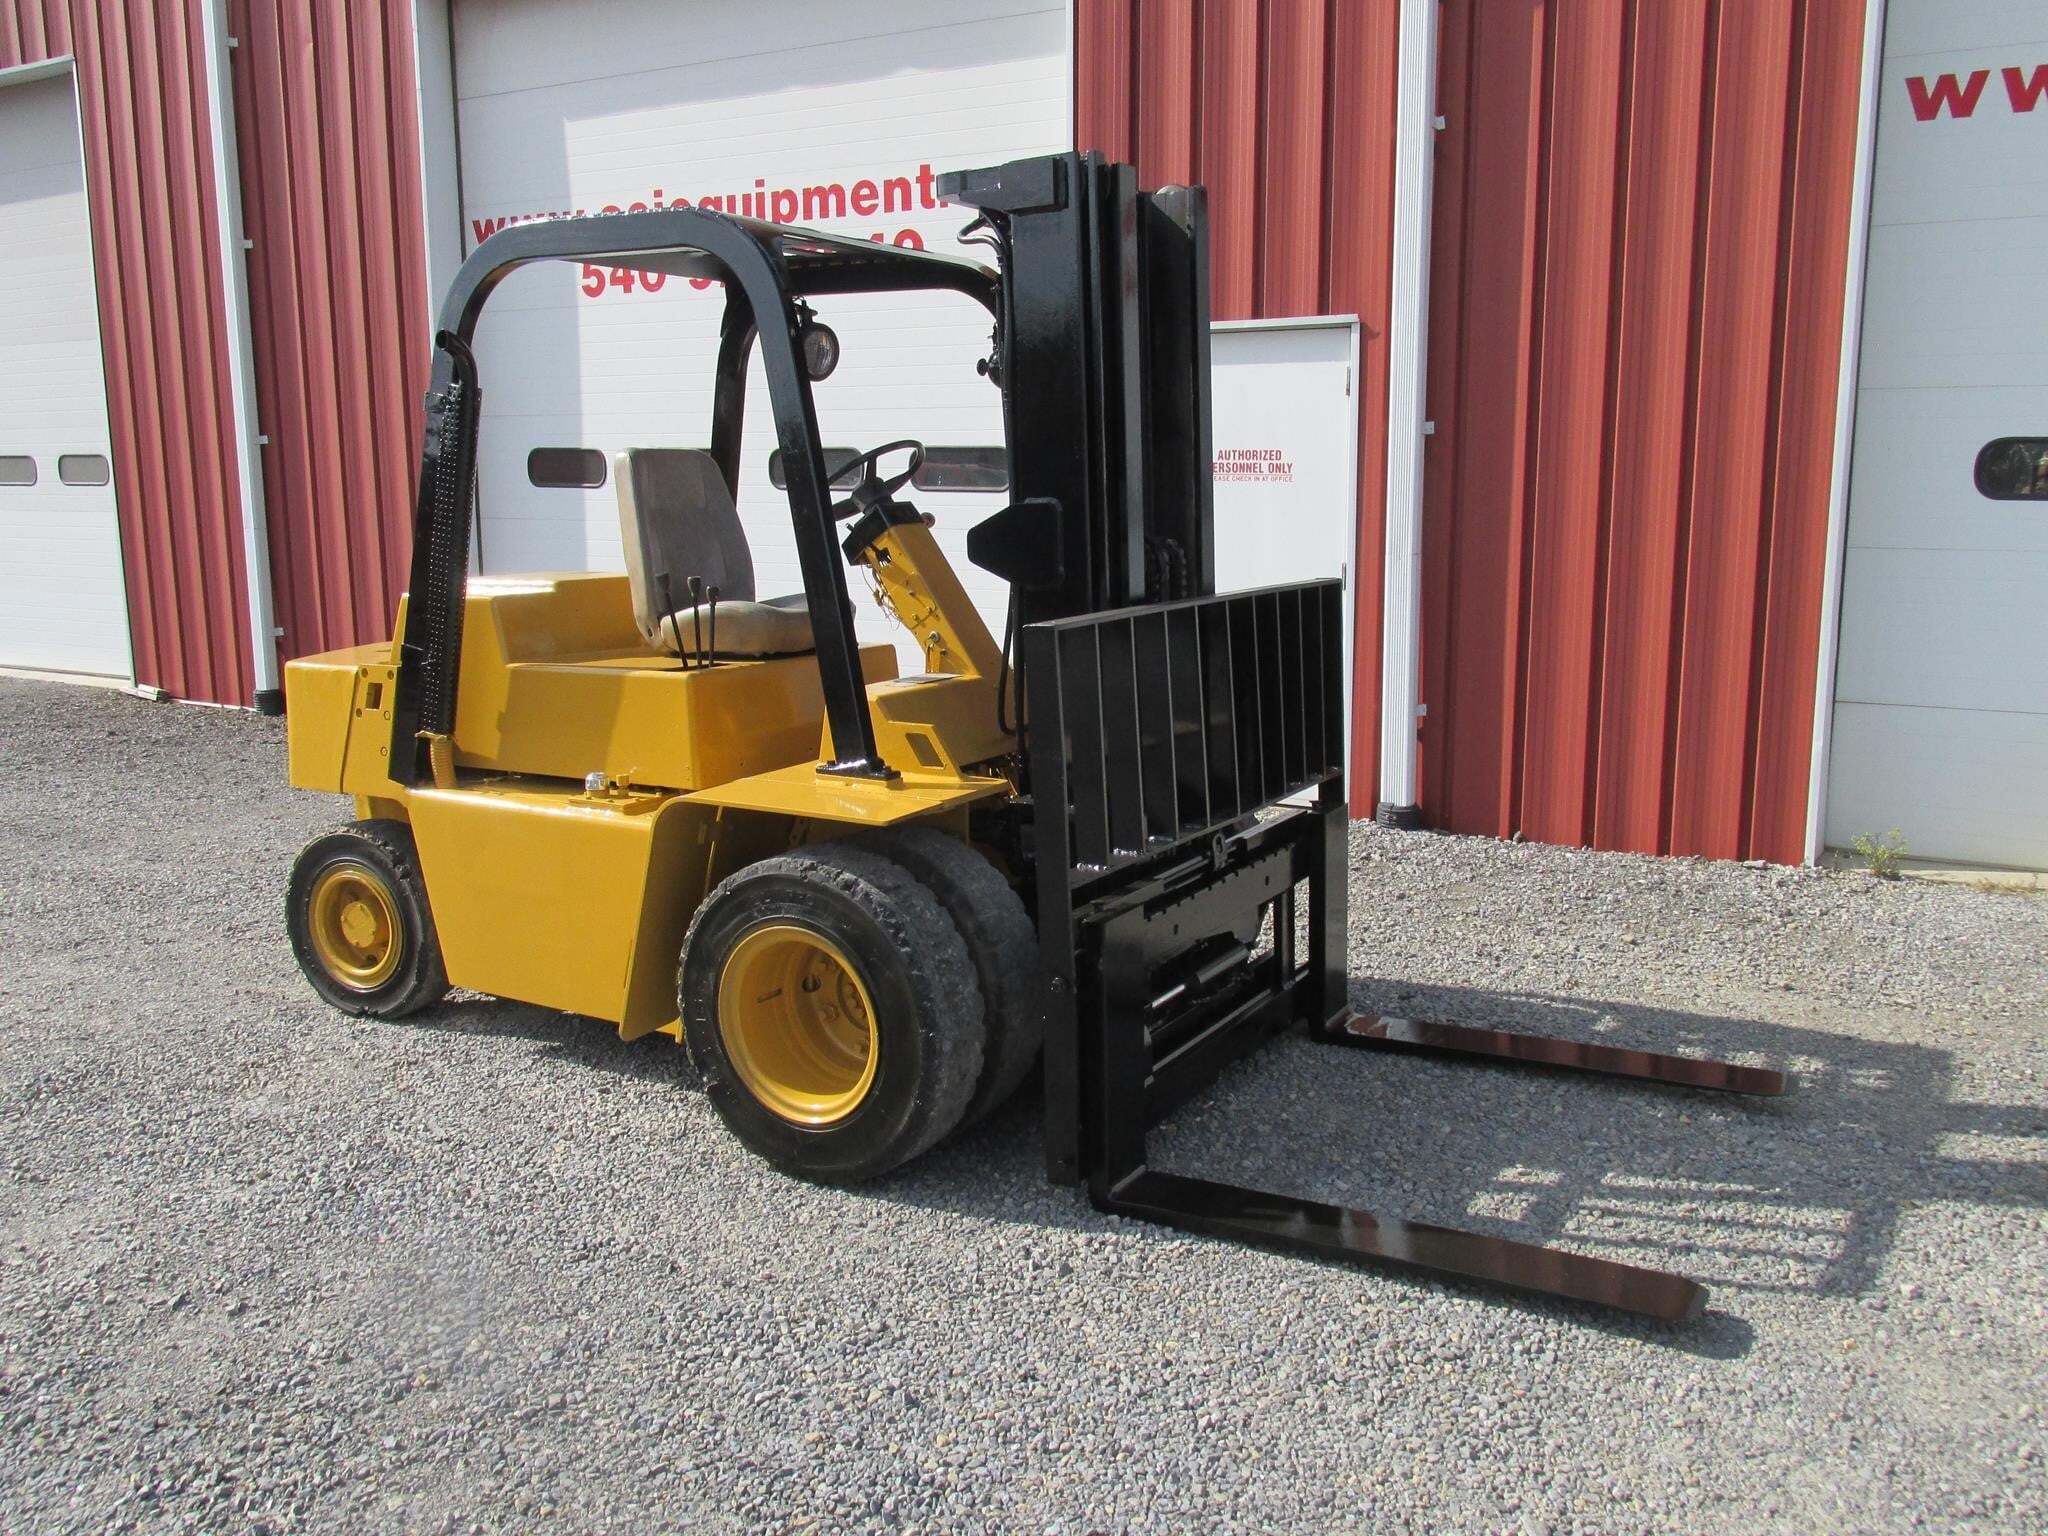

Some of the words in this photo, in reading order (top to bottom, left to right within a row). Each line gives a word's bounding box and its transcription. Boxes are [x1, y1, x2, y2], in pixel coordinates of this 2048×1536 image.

[1217, 449, 1282, 461] AUTHORIZED
[1212, 462, 1264, 474] ERSONNEL
[1268, 462, 1293, 474] ONLY
